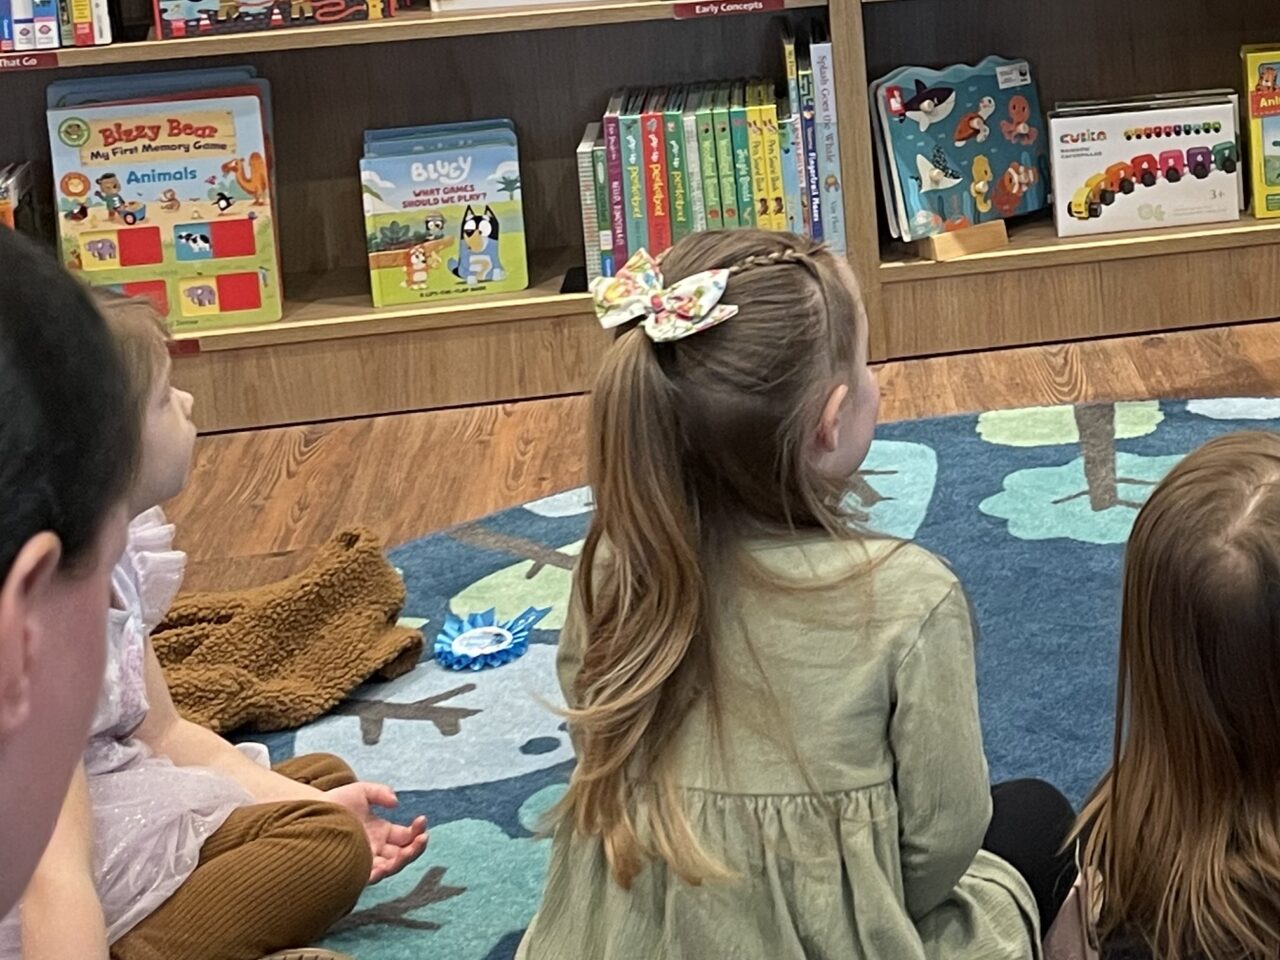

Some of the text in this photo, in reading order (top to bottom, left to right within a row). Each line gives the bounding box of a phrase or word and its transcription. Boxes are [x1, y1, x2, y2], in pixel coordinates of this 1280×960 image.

[694, 0, 764, 17] Early Concepts
[21, 55, 38, 67] Go
[818, 55, 837, 163] Splash Goes the Whale
[98, 118, 218, 147] Bizzy Bear
[90, 140, 228, 161] My First Memory Game
[126, 167, 198, 185] Animals
[410, 155, 472, 184] BLUEY
[413, 184, 475, 198] WHAT GAMES
[1210, 189, 1225, 200] 3+
[402, 192, 488, 209] SHOULD WE PLAY?
